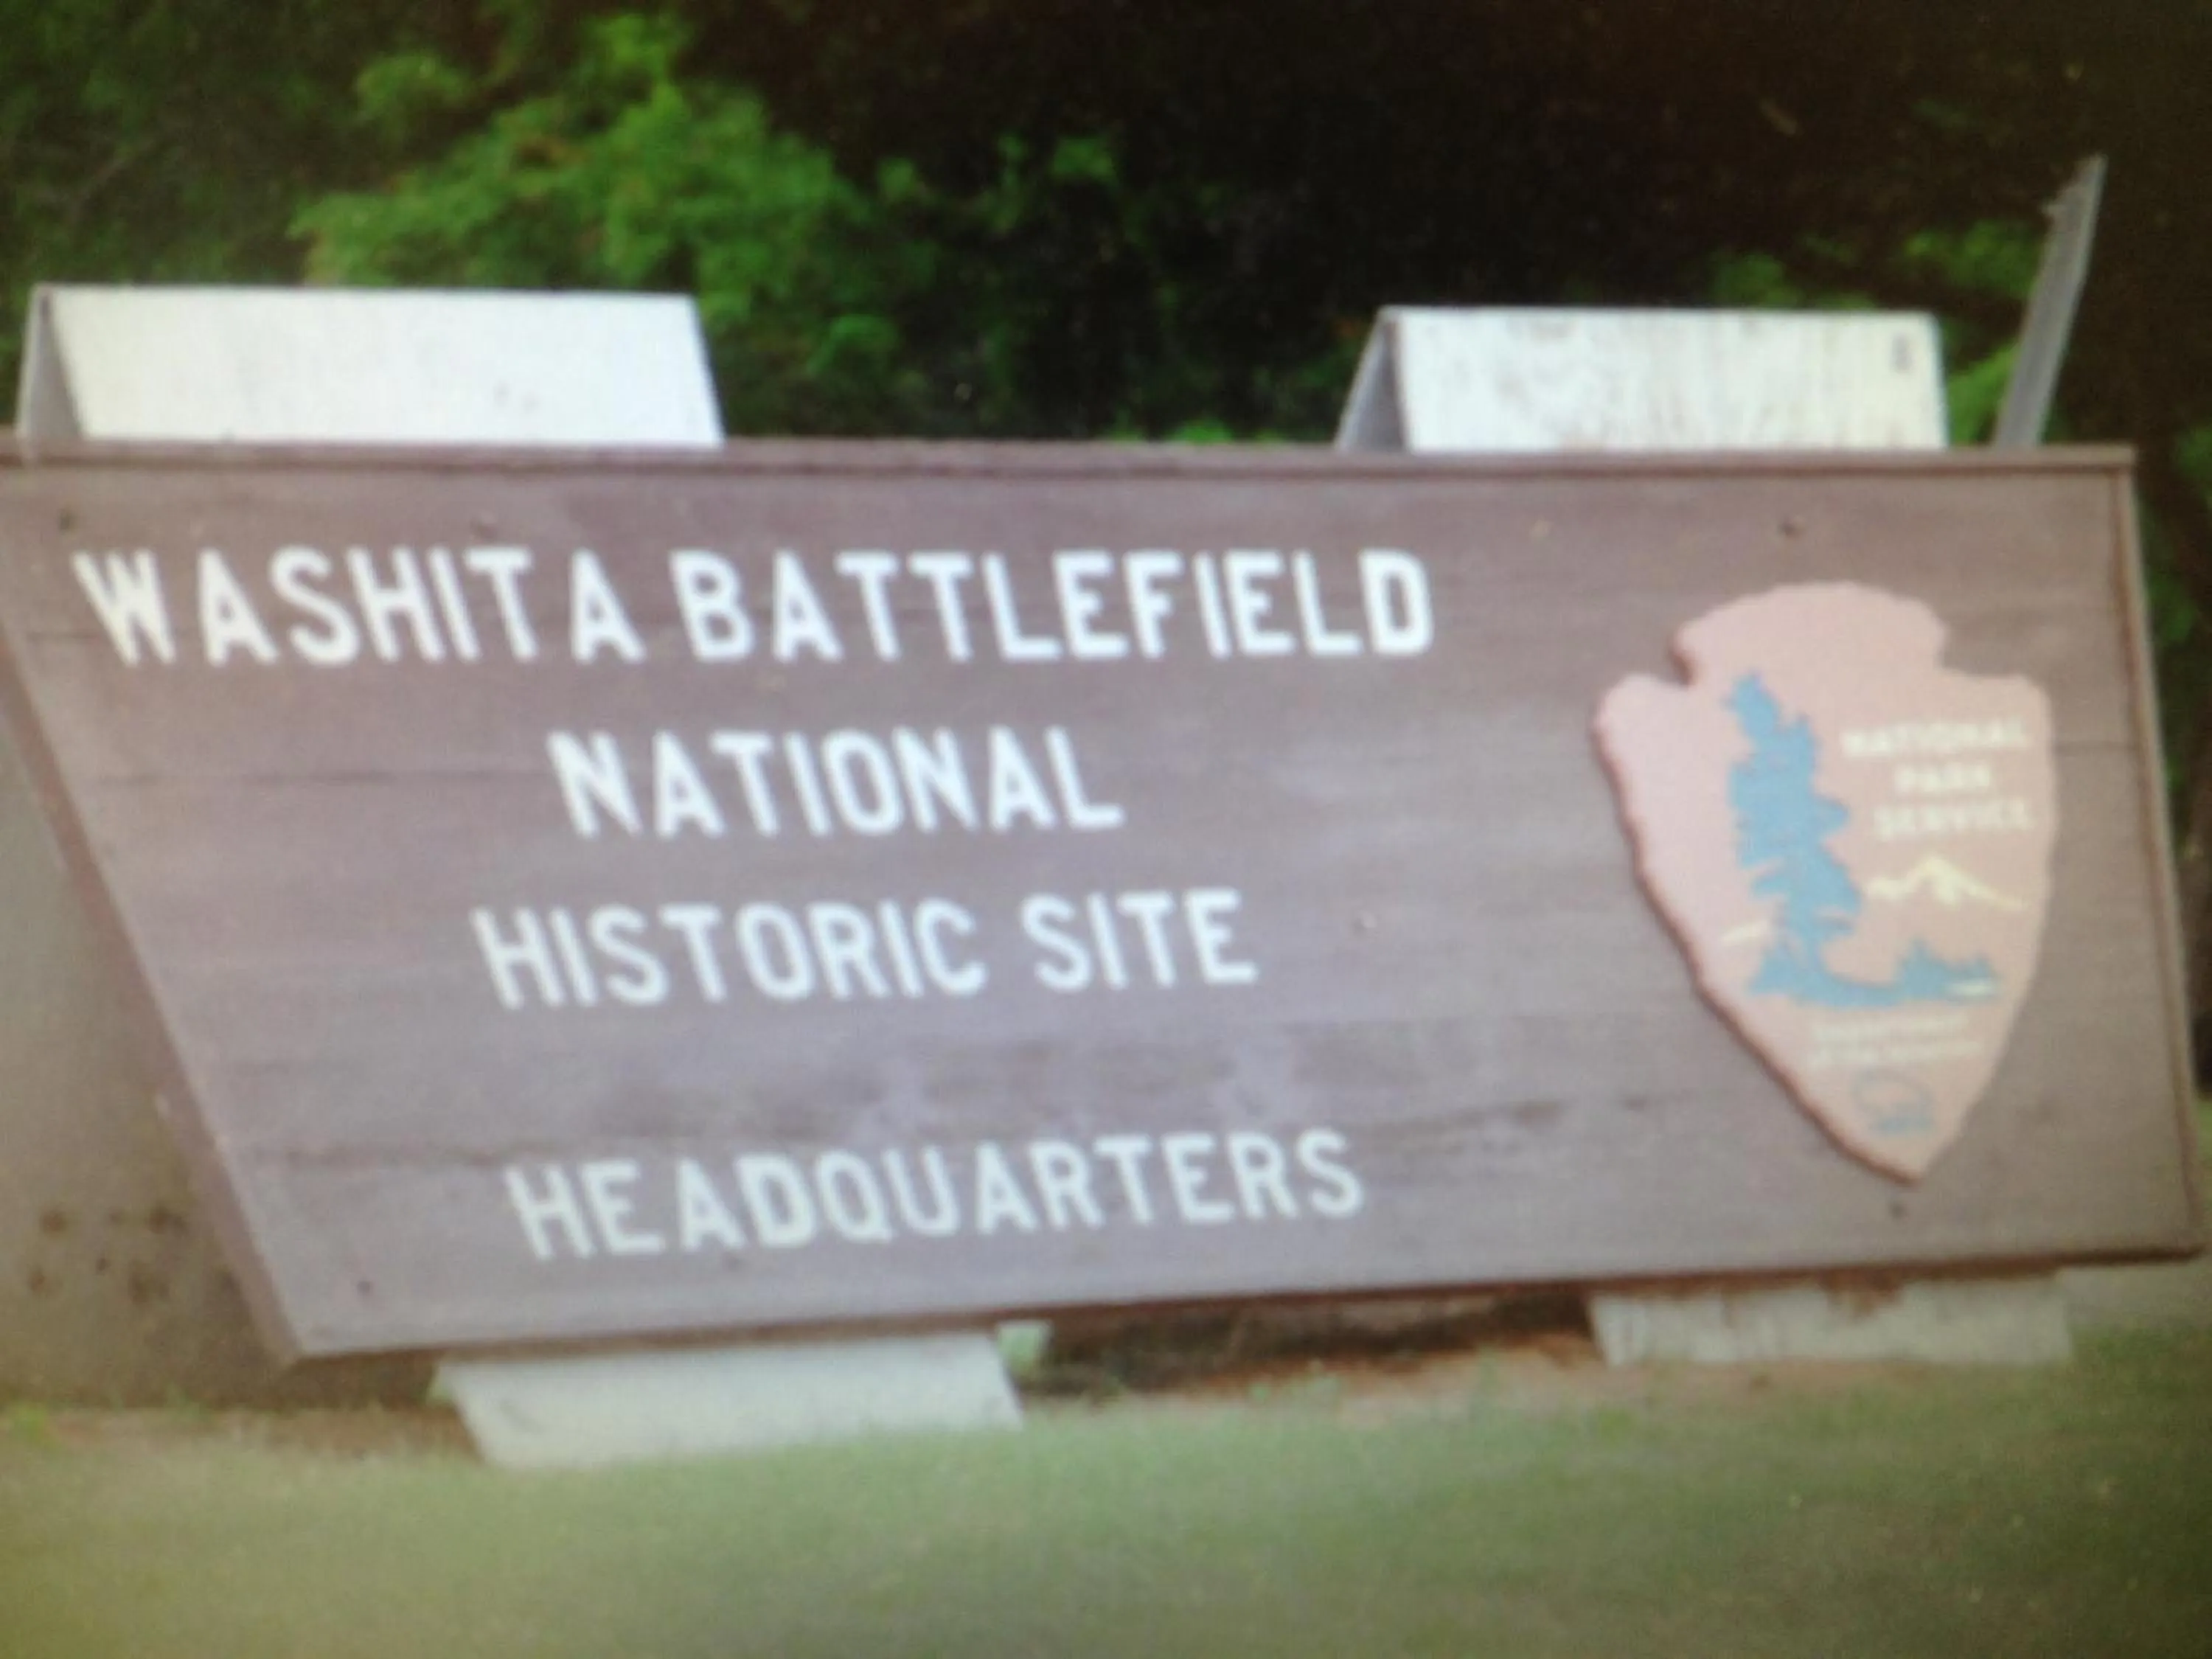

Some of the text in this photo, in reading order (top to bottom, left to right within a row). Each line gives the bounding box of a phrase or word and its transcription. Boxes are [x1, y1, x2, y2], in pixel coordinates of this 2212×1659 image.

[71, 546, 1435, 667] WASHITA BATTLEFIELD
[546, 726, 1124, 839] NATIONAL
[1841, 717, 2033, 758] NATIONAL
[470, 888, 1260, 1009] HISTORIC SITE
[504, 1129, 1364, 1260] HEADQUARTERS
